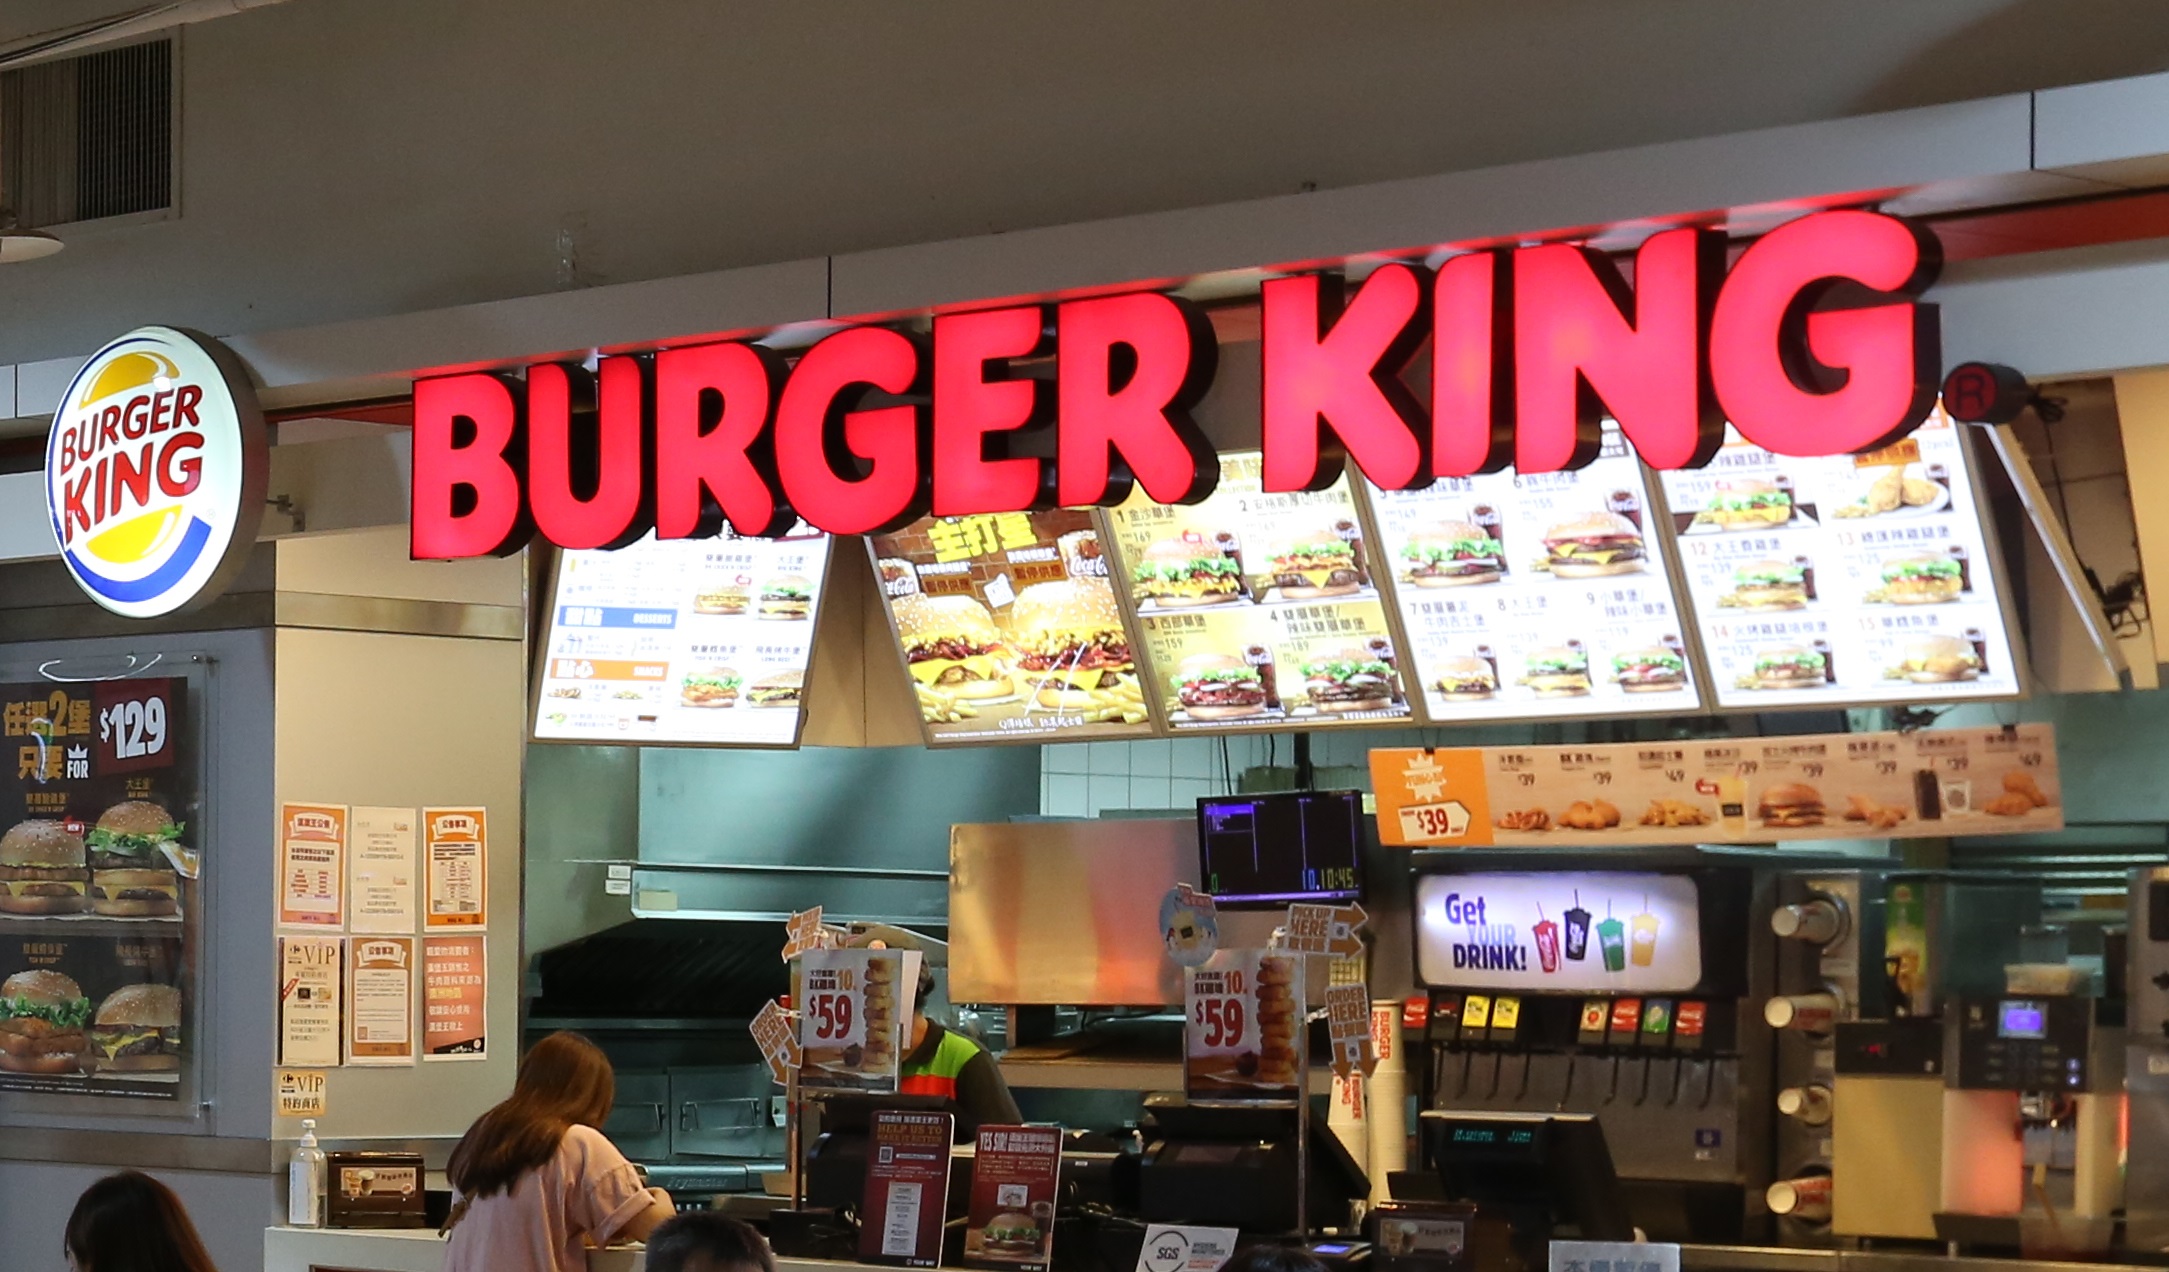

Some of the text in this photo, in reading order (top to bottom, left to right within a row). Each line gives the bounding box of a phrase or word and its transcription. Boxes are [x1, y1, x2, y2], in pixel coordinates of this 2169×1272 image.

[412, 209, 1922, 562] BURGER KING
[60, 384, 203, 477] BURGER
[64, 431, 205, 545] KING
[1238, 499, 1248, 512] 2
[1117, 509, 1125, 523] 1
[1836, 531, 1854, 545] 13
[1690, 541, 1708, 555] 12
[1409, 601, 1417, 615] 7
[1497, 598, 1506, 612] 8
[1586, 592, 1595, 605] 9
[1270, 609, 1278, 622] 4
[1858, 616, 1875, 630] 15
[1712, 624, 1728, 639] 14
[99, 696, 167, 760] $129
[66, 759, 89, 779] FOR
[1417, 808, 1449, 836] $39
[1445, 892, 1487, 926] Get
[1466, 923, 1517, 946] YOUR
[1453, 943, 1527, 972] DRINK!
[809, 994, 852, 1039] $59
[1195, 998, 1244, 1047] $59
[297, 1074, 324, 1093] VIP
[1156, 1246, 1180, 1260] SGS
